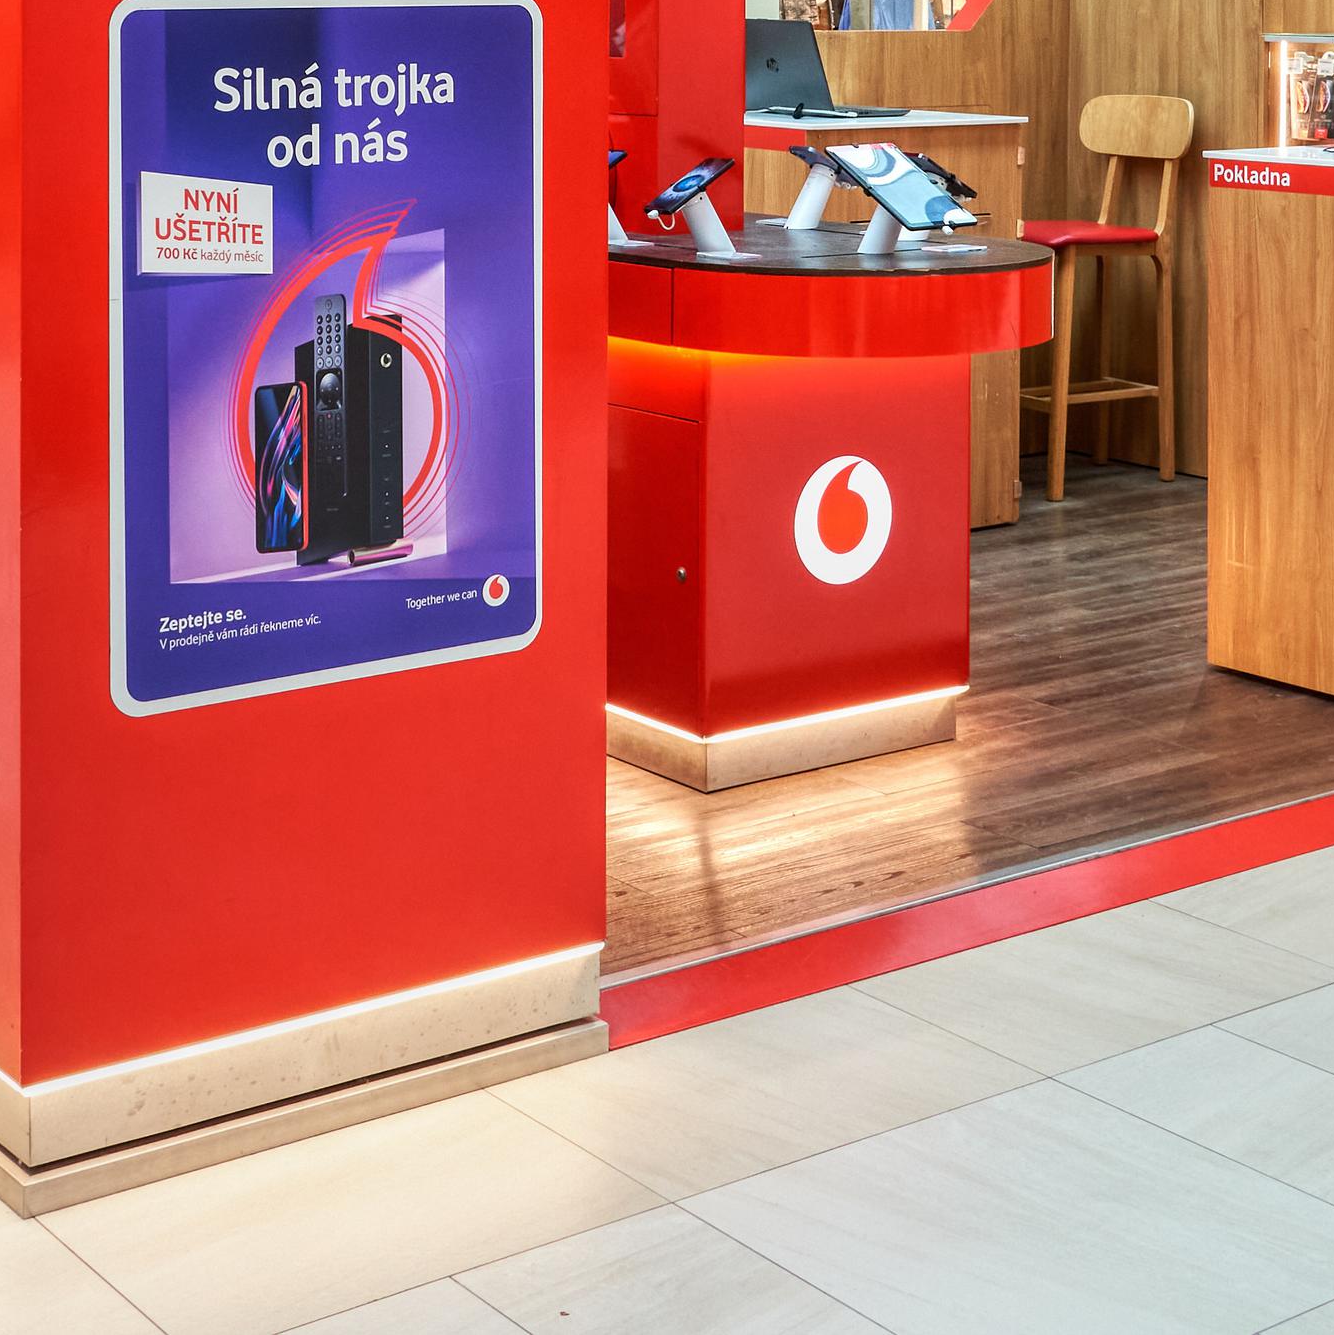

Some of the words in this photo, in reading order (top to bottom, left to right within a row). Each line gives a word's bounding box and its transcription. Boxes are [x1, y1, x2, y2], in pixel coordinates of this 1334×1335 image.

[213, 62, 323, 113] Silná
[334, 63, 455, 116] trojka
[266, 123, 320, 168] od
[334, 117, 408, 165] nás
[1213, 163, 1291, 189] Pokladna
[183, 187, 240, 214] NYNÍ
[155, 212, 264, 246] UŠETŘÍTE
[155, 247, 180, 260] 700
[182, 246, 198, 261] Kč
[200, 247, 232, 265] každý
[234, 248, 264, 263] měsíc
[406, 593, 445, 610] Together
[447, 592, 461, 603] we
[461, 589, 478, 600] can
[160, 610, 223, 635] Zeptejte
[225, 607, 247, 623] se.
[160, 638, 168, 650] V
[169, 629, 215, 651] prodejně
[216, 625, 238, 641] vám
[239, 622, 259, 637] rádi
[260, 617, 304, 635] řekneme
[305, 613, 322, 627] víc.
